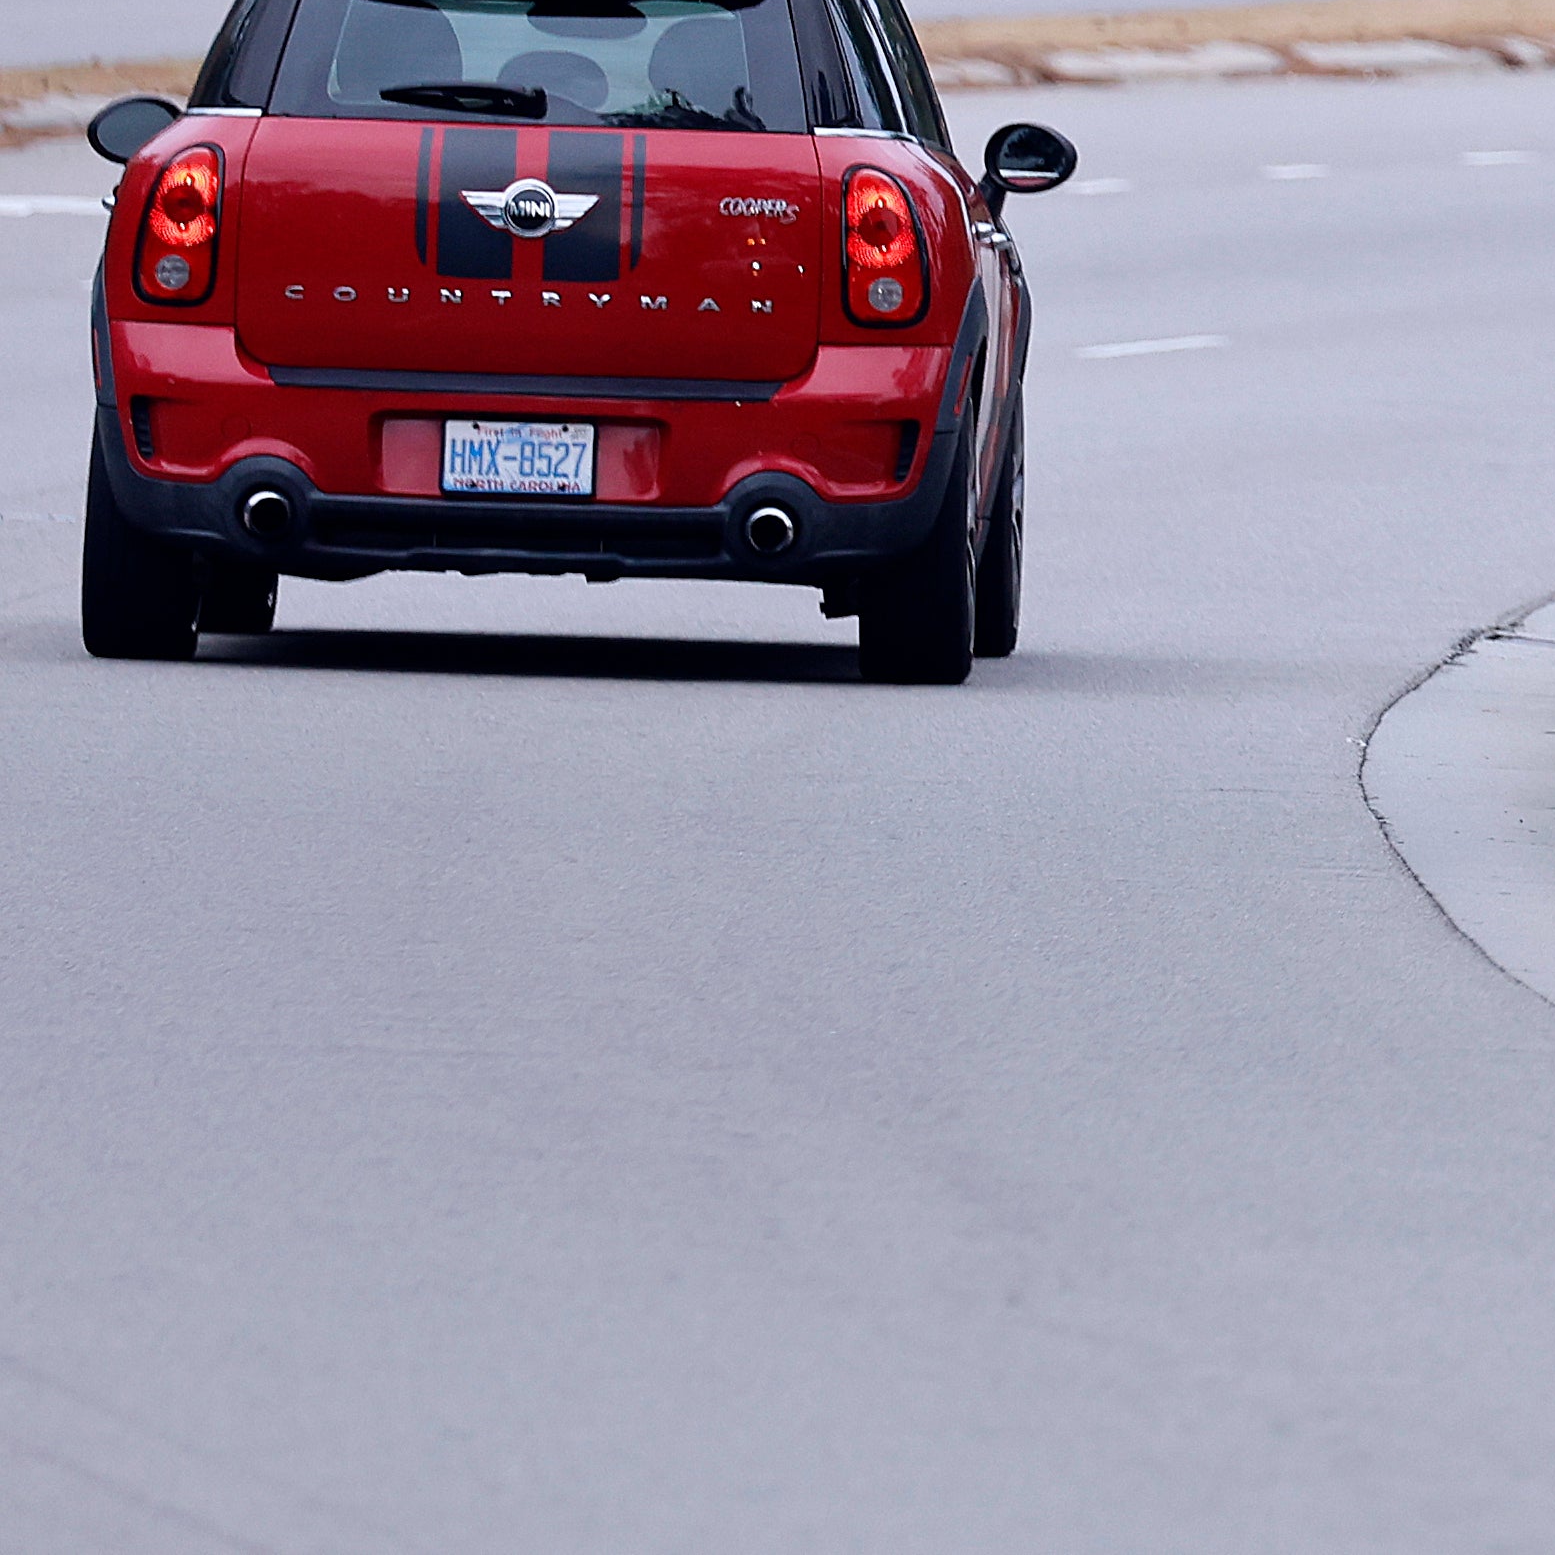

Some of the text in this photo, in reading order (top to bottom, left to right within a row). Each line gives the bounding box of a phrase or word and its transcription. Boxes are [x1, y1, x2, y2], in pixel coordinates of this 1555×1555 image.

[510, 201, 551, 218] MINI
[284, 284, 774, 315] COUNTRYMAN
[450, 438, 588, 479] HMX-8527
